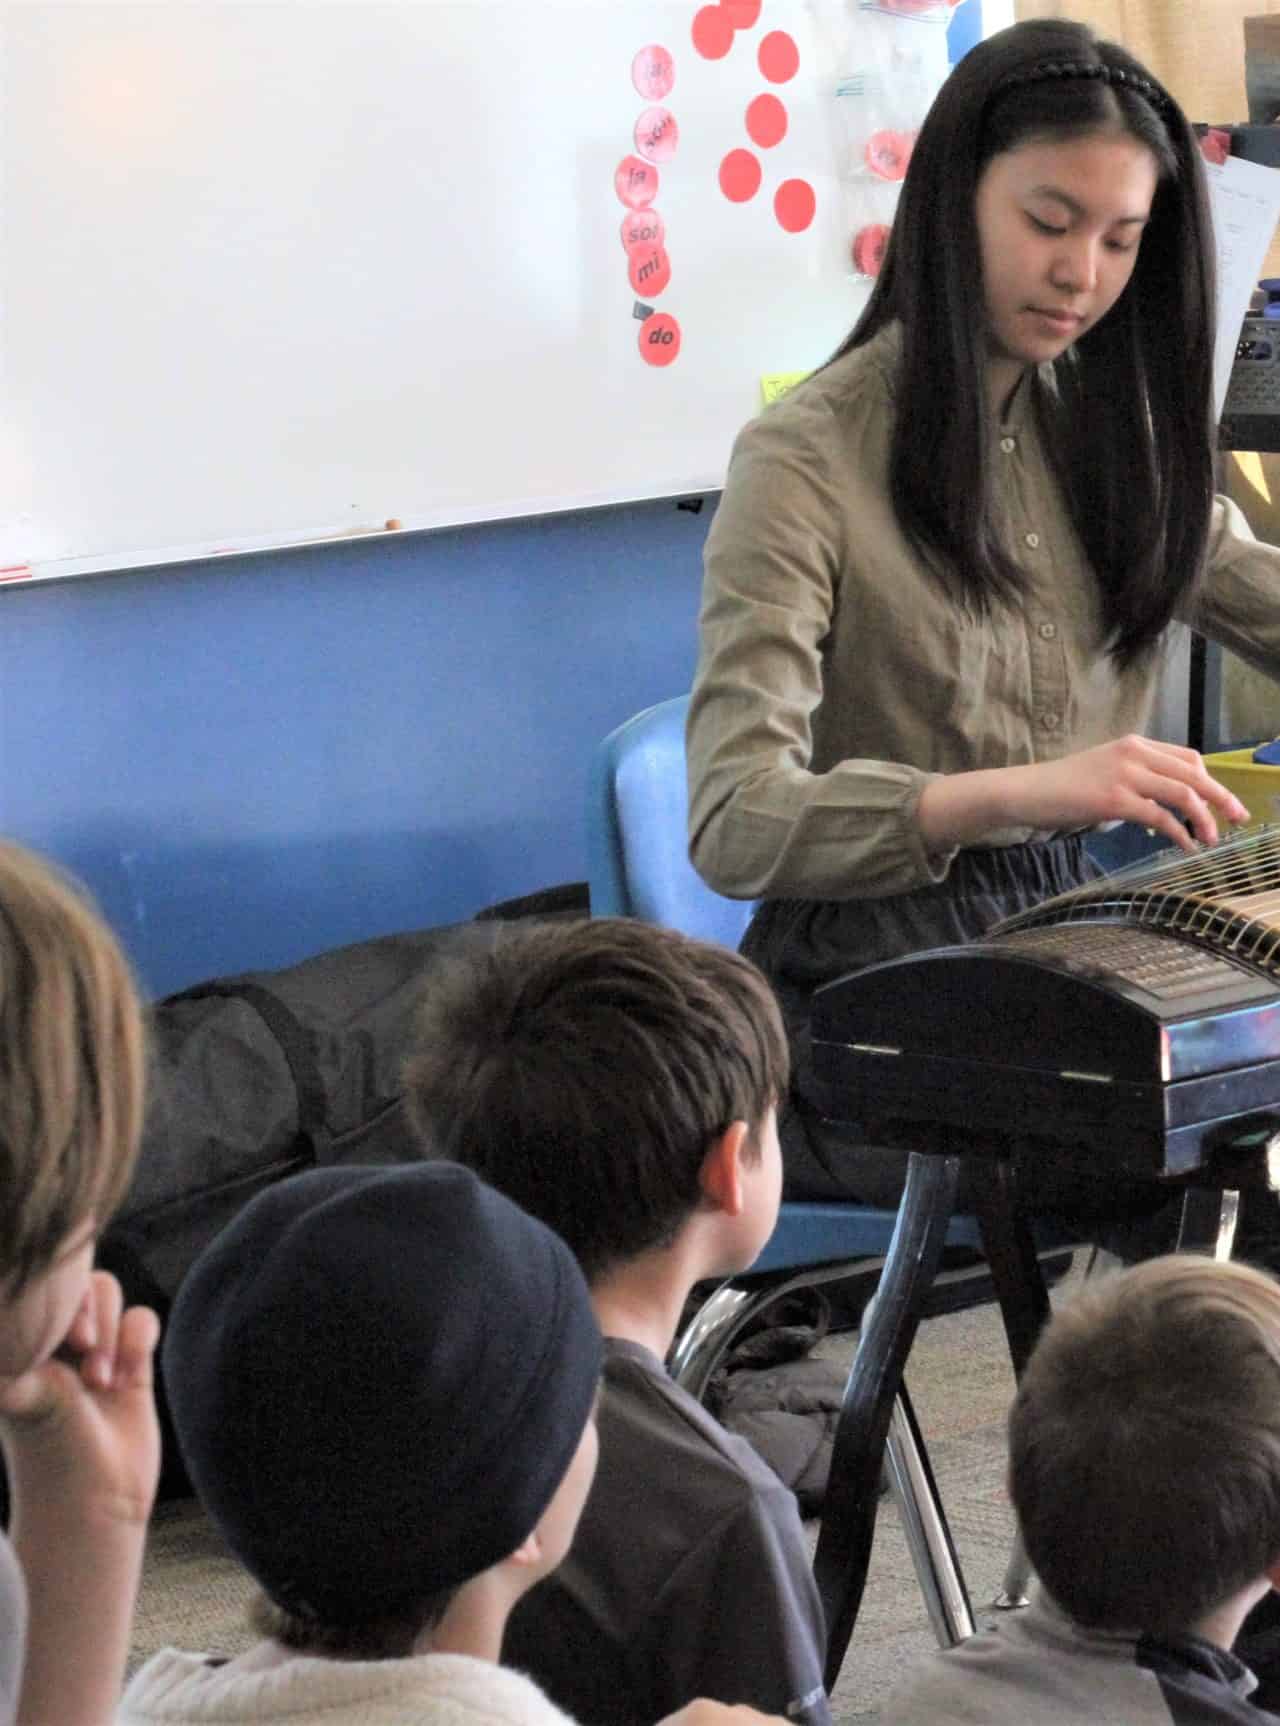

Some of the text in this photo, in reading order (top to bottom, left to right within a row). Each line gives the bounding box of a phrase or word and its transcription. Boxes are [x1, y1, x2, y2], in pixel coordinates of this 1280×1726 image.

[628, 224, 658, 243] sol
[637, 251, 660, 283] mi
[648, 326, 673, 344] do
